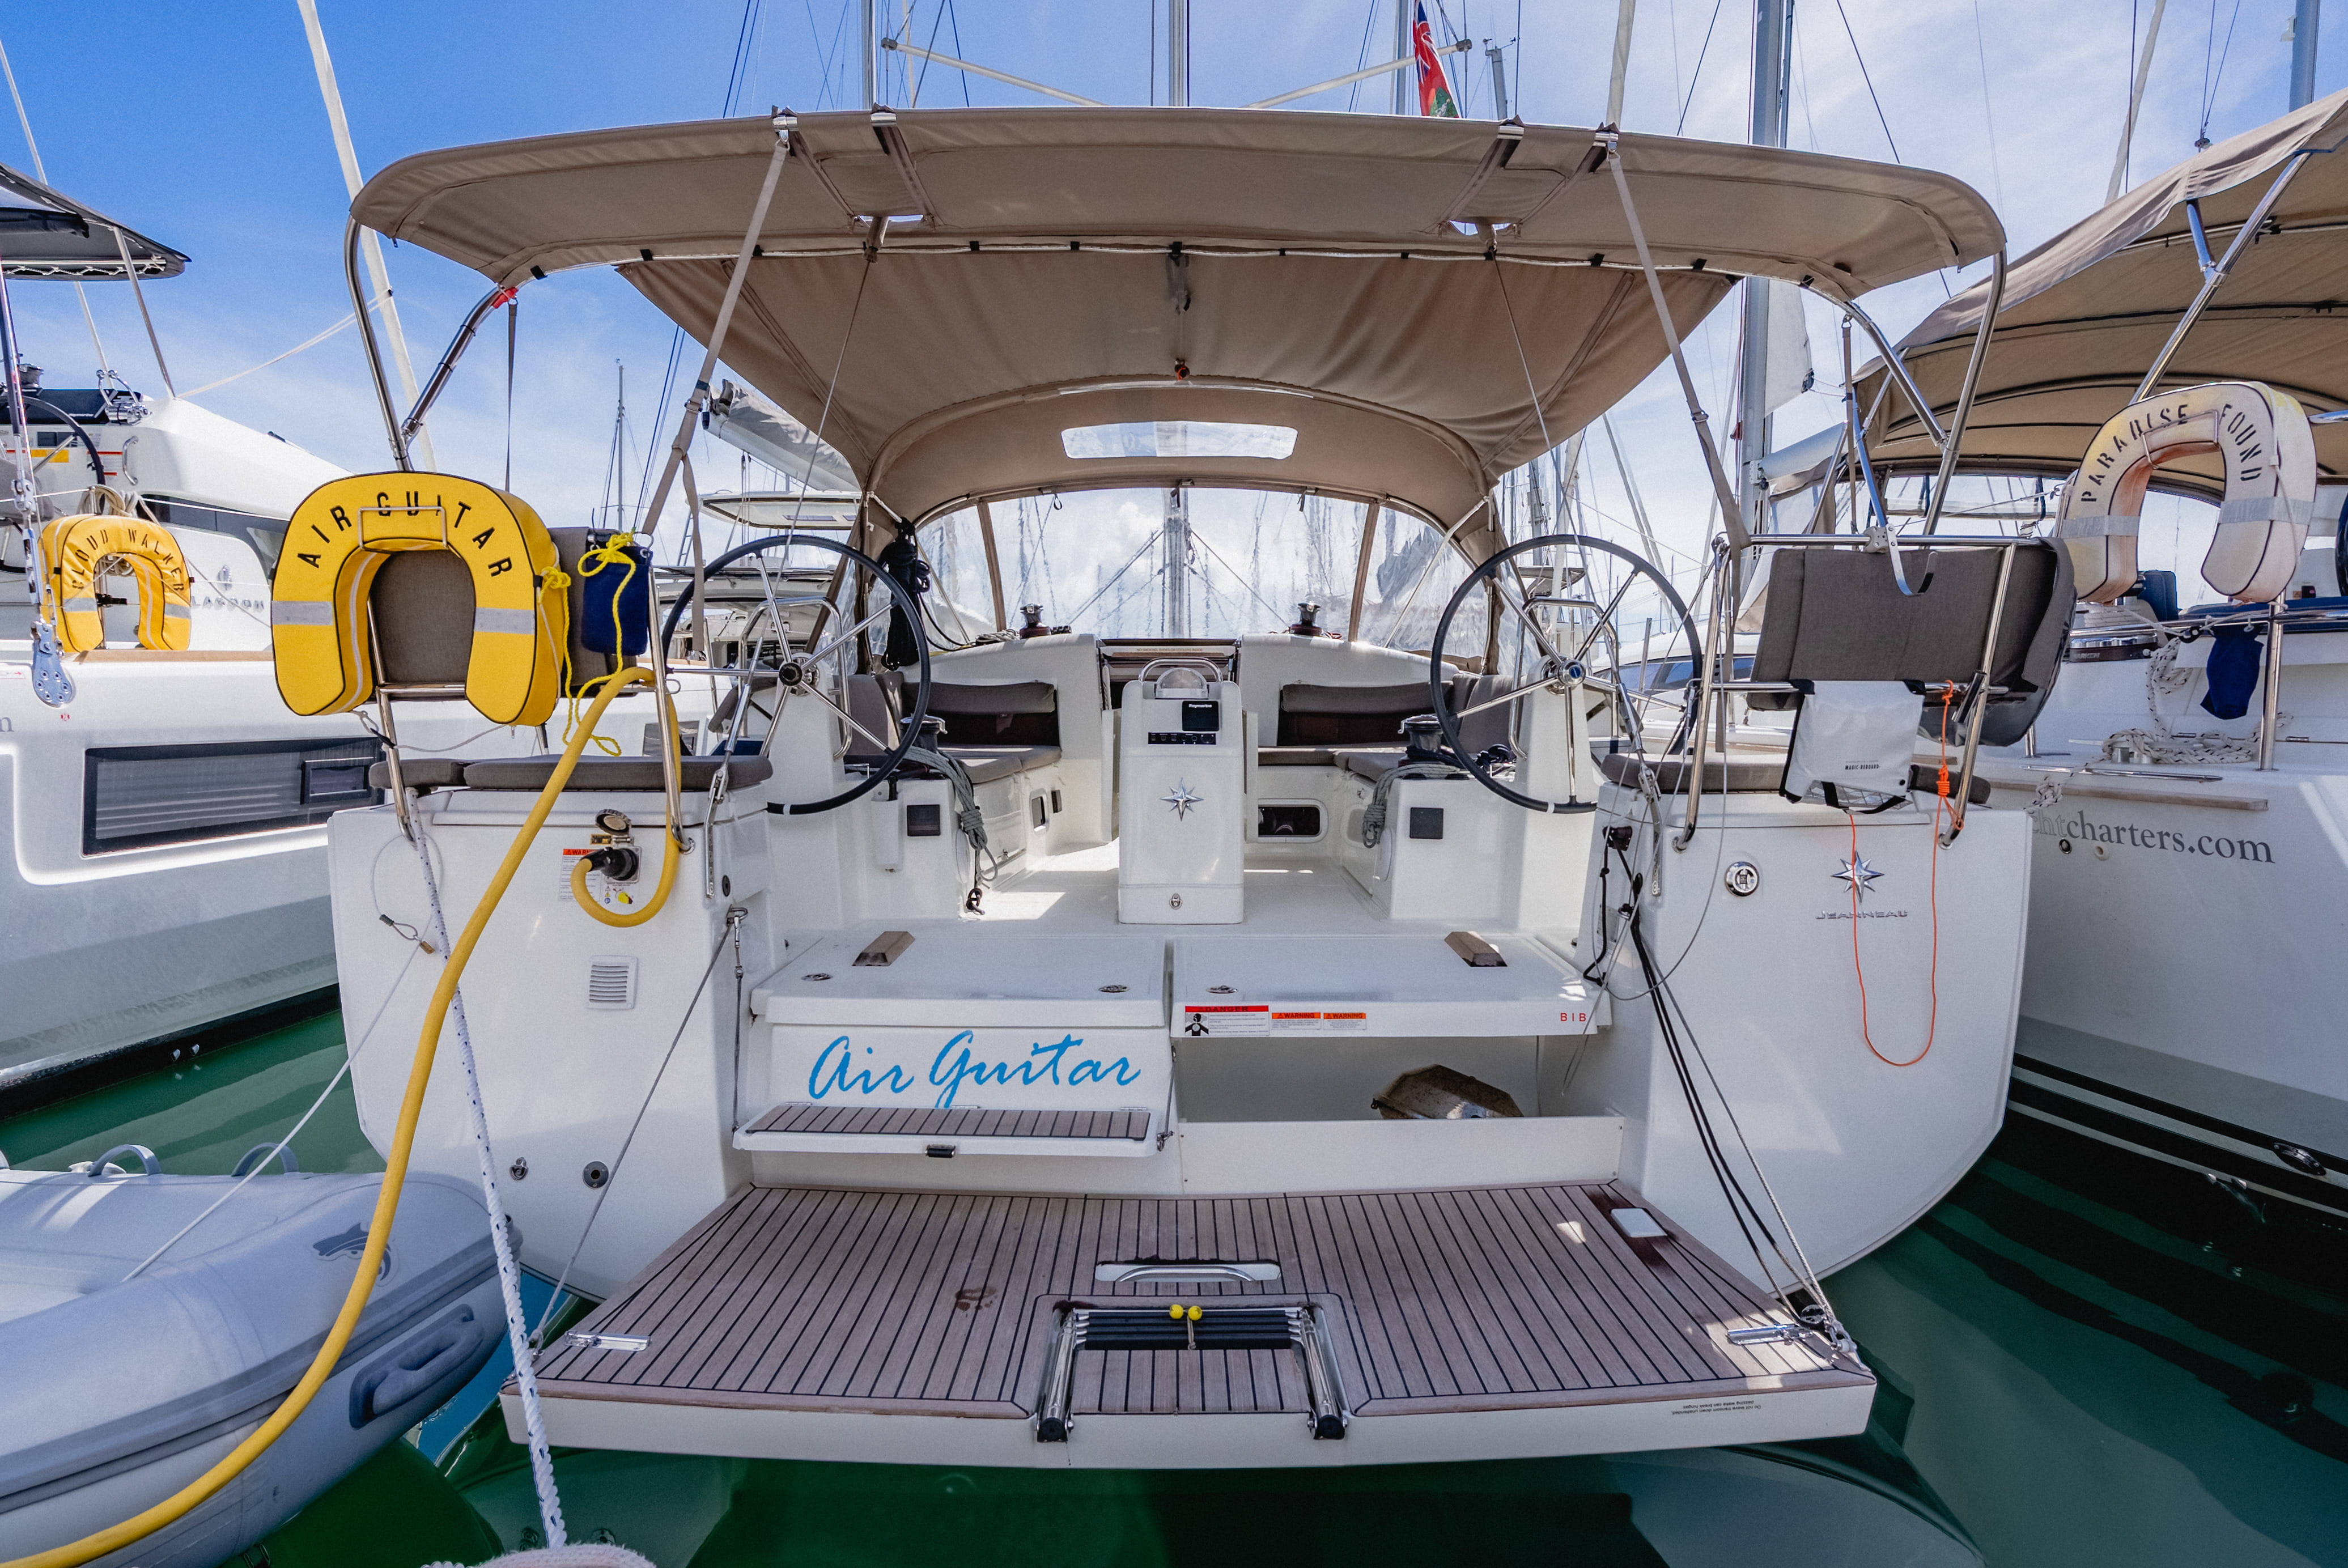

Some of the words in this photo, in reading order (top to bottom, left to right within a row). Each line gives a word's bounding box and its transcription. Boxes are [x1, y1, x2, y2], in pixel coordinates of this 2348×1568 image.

[2080, 403, 2189, 503] PARADISE
[2220, 403, 2262, 482] FOUND
[128, 528, 185, 592] WALKER
[297, 504, 353, 568] AIR
[376, 491, 513, 577] GUITAR
[191, 595, 265, 611] LAGOON
[1815, 910, 1908, 920] JEANNEAU
[1560, 1012, 1586, 1022] BIB
[808, 1035, 914, 1099] Air
[929, 1030, 1141, 1108] Guitar
